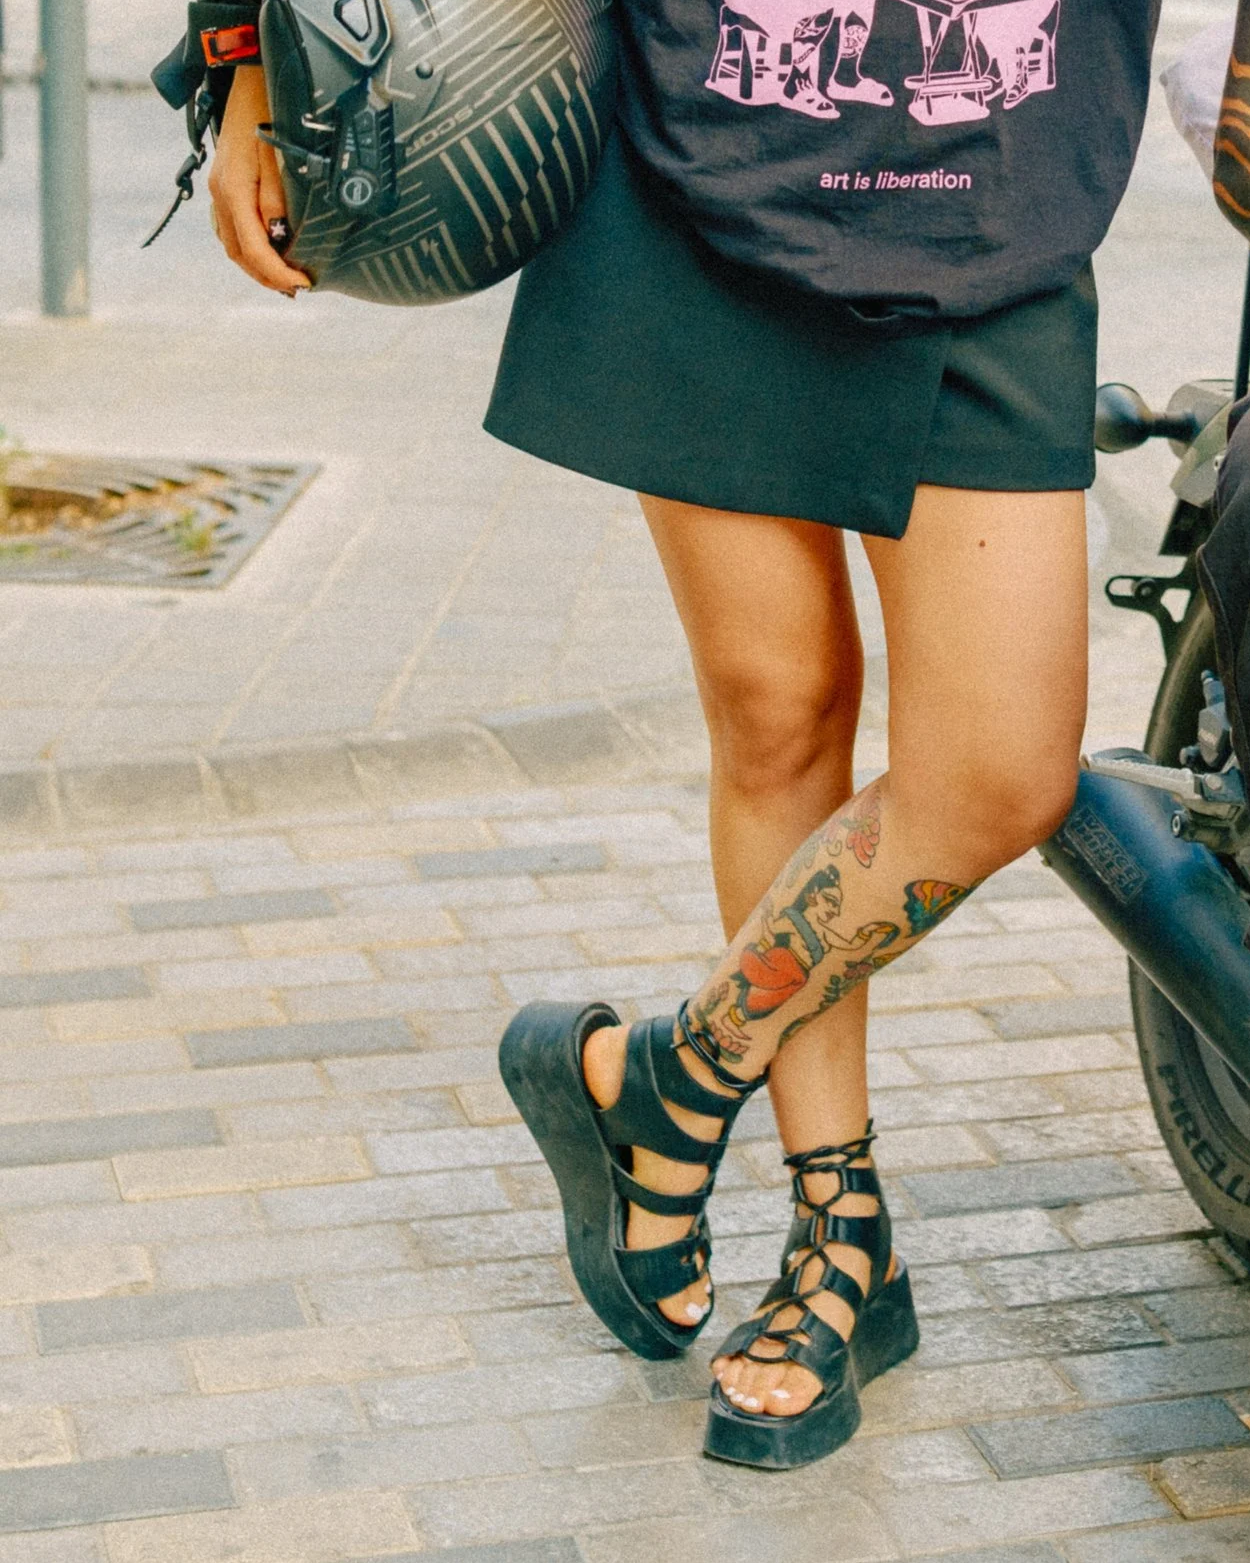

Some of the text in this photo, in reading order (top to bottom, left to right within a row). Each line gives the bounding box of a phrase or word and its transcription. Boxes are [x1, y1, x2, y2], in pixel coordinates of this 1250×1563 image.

[819, 168, 972, 190] art is liberation
